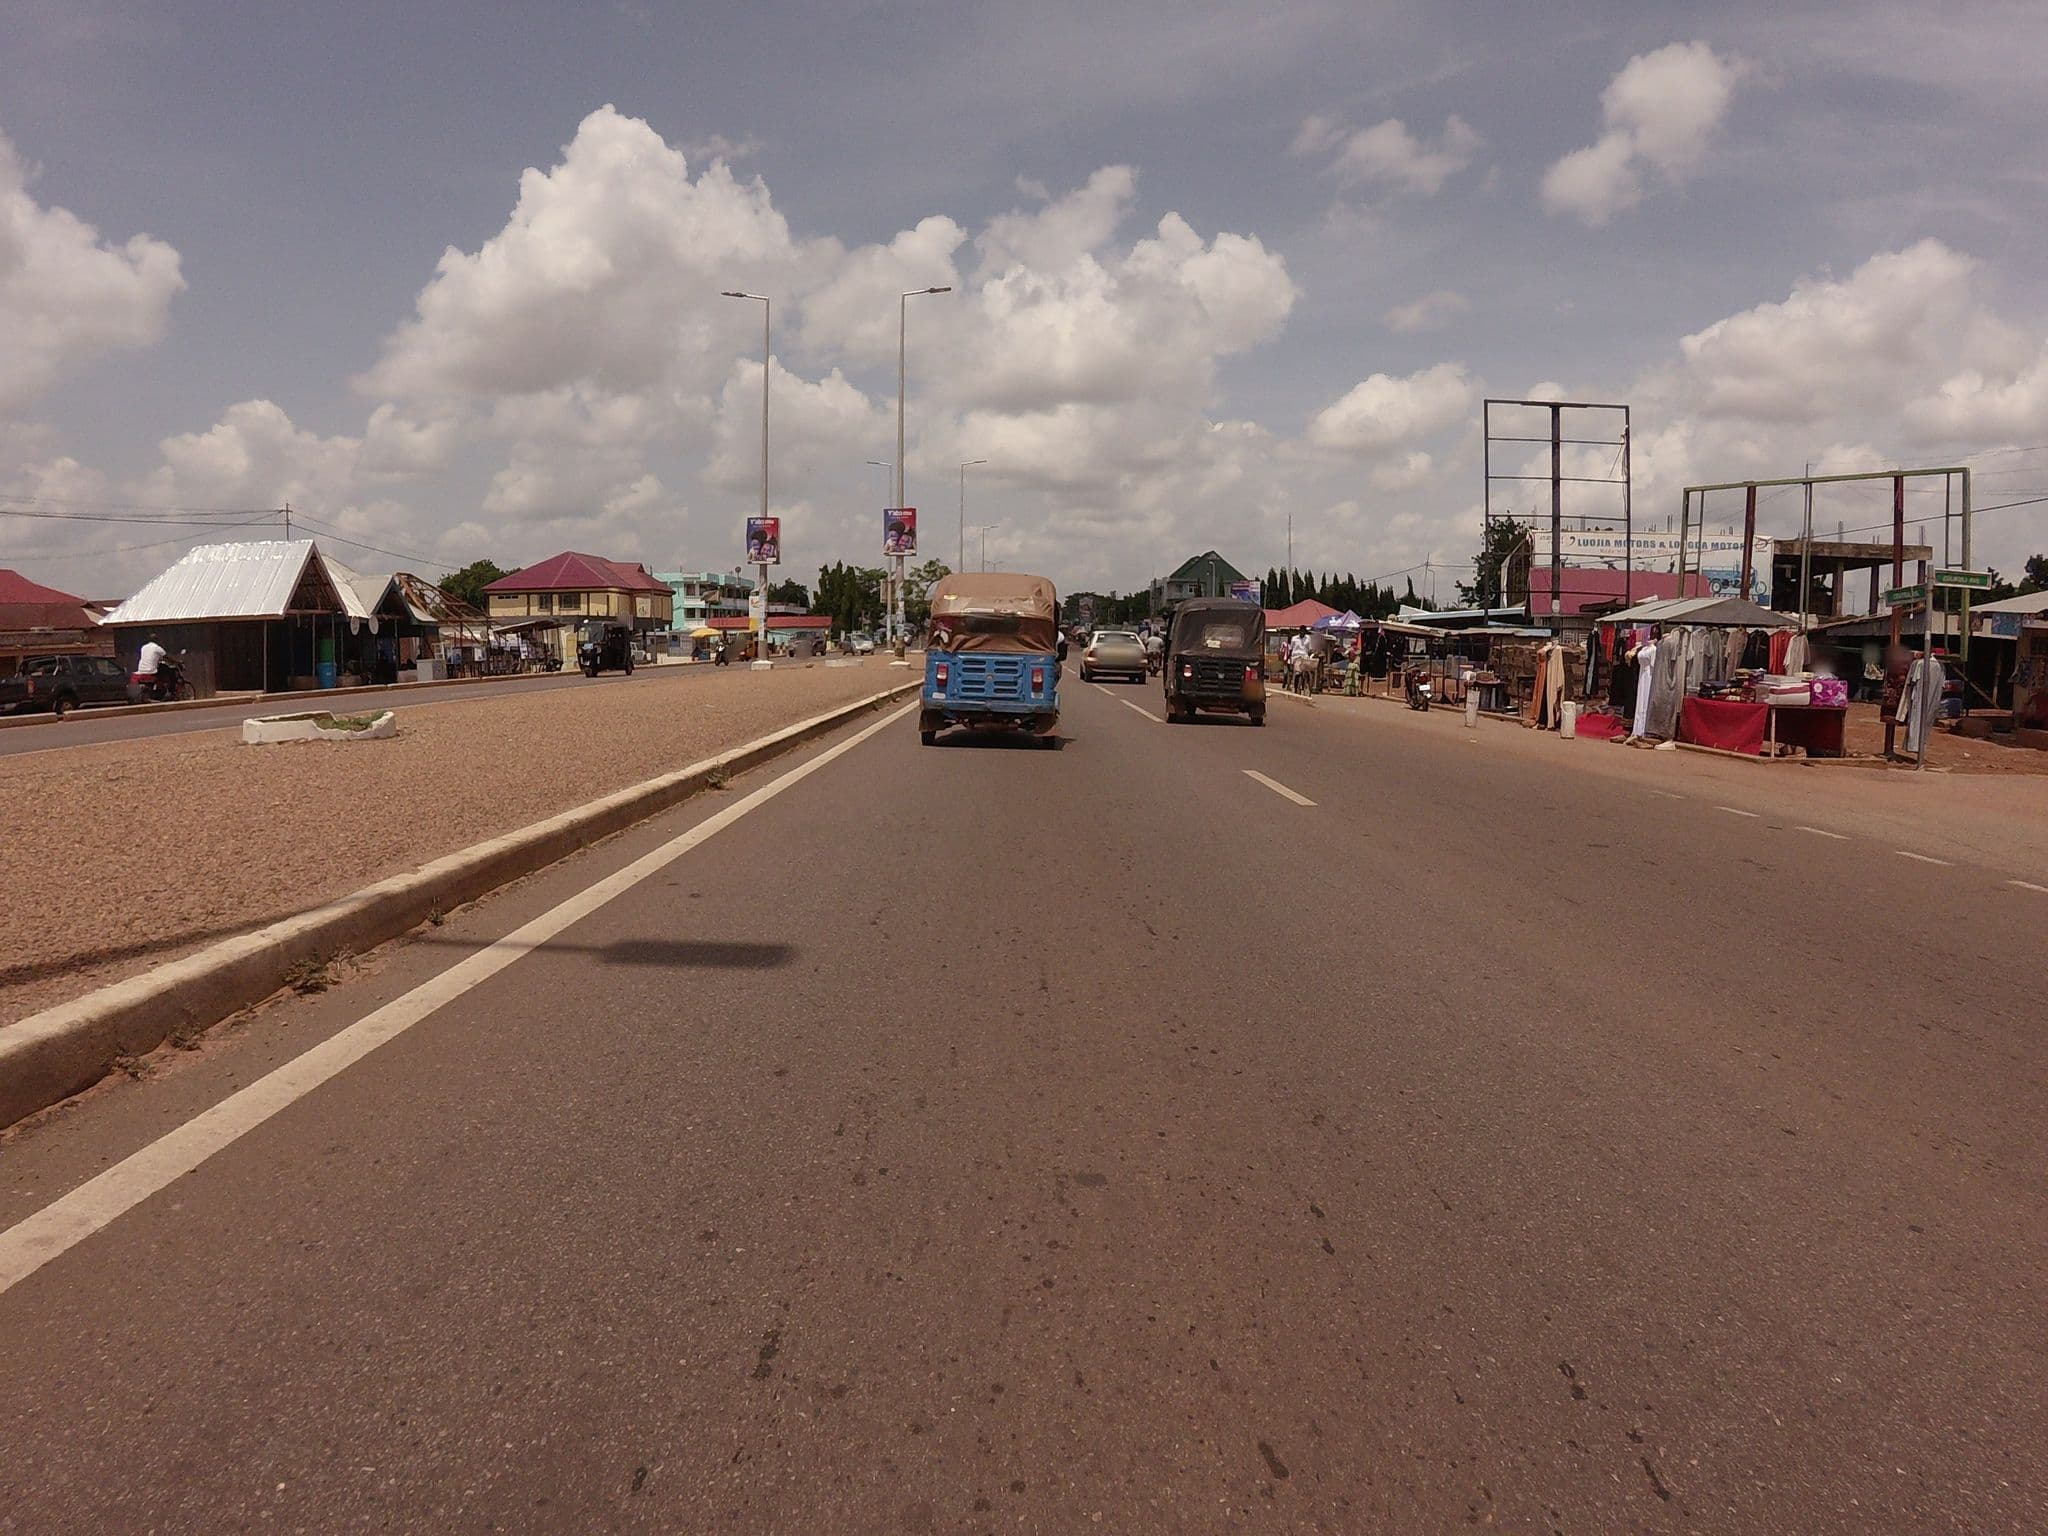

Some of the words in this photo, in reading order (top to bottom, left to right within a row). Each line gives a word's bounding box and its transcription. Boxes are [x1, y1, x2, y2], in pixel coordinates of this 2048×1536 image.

[1577, 538, 1611, 547] LUOJIA
[1614, 539, 1656, 548] MOTORS
[1669, 541, 1708, 550] LOGDA
